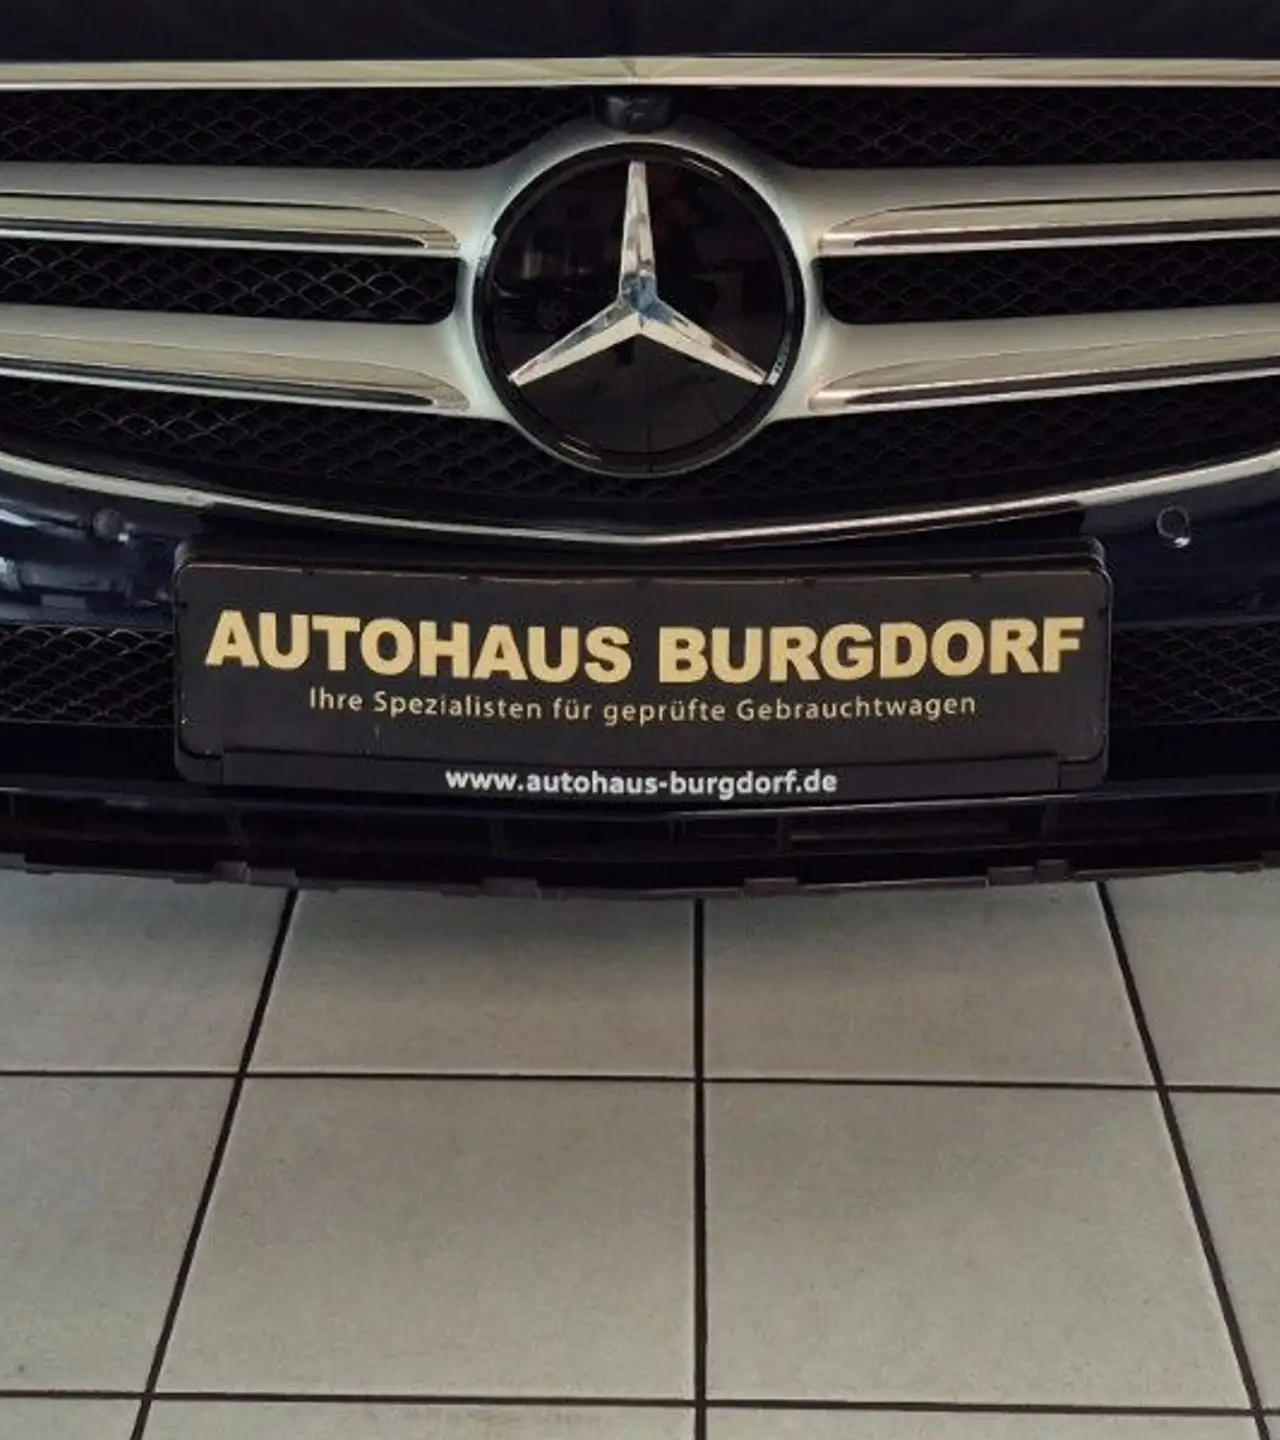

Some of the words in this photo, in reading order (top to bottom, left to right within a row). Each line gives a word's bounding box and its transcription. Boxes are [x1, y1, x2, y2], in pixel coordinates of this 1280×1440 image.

[204, 609, 632, 684] AUTOHAUS
[658, 616, 1086, 685] BURGDORF
[309, 686, 364, 712] Ihre
[373, 690, 542, 719] Spezialisten
[552, 697, 592, 721] für
[603, 698, 726, 727] geprüfte
[736, 694, 977, 722] Gebrauchtwagen
[444, 768, 839, 800] www.autohaus-burgdorf.de
